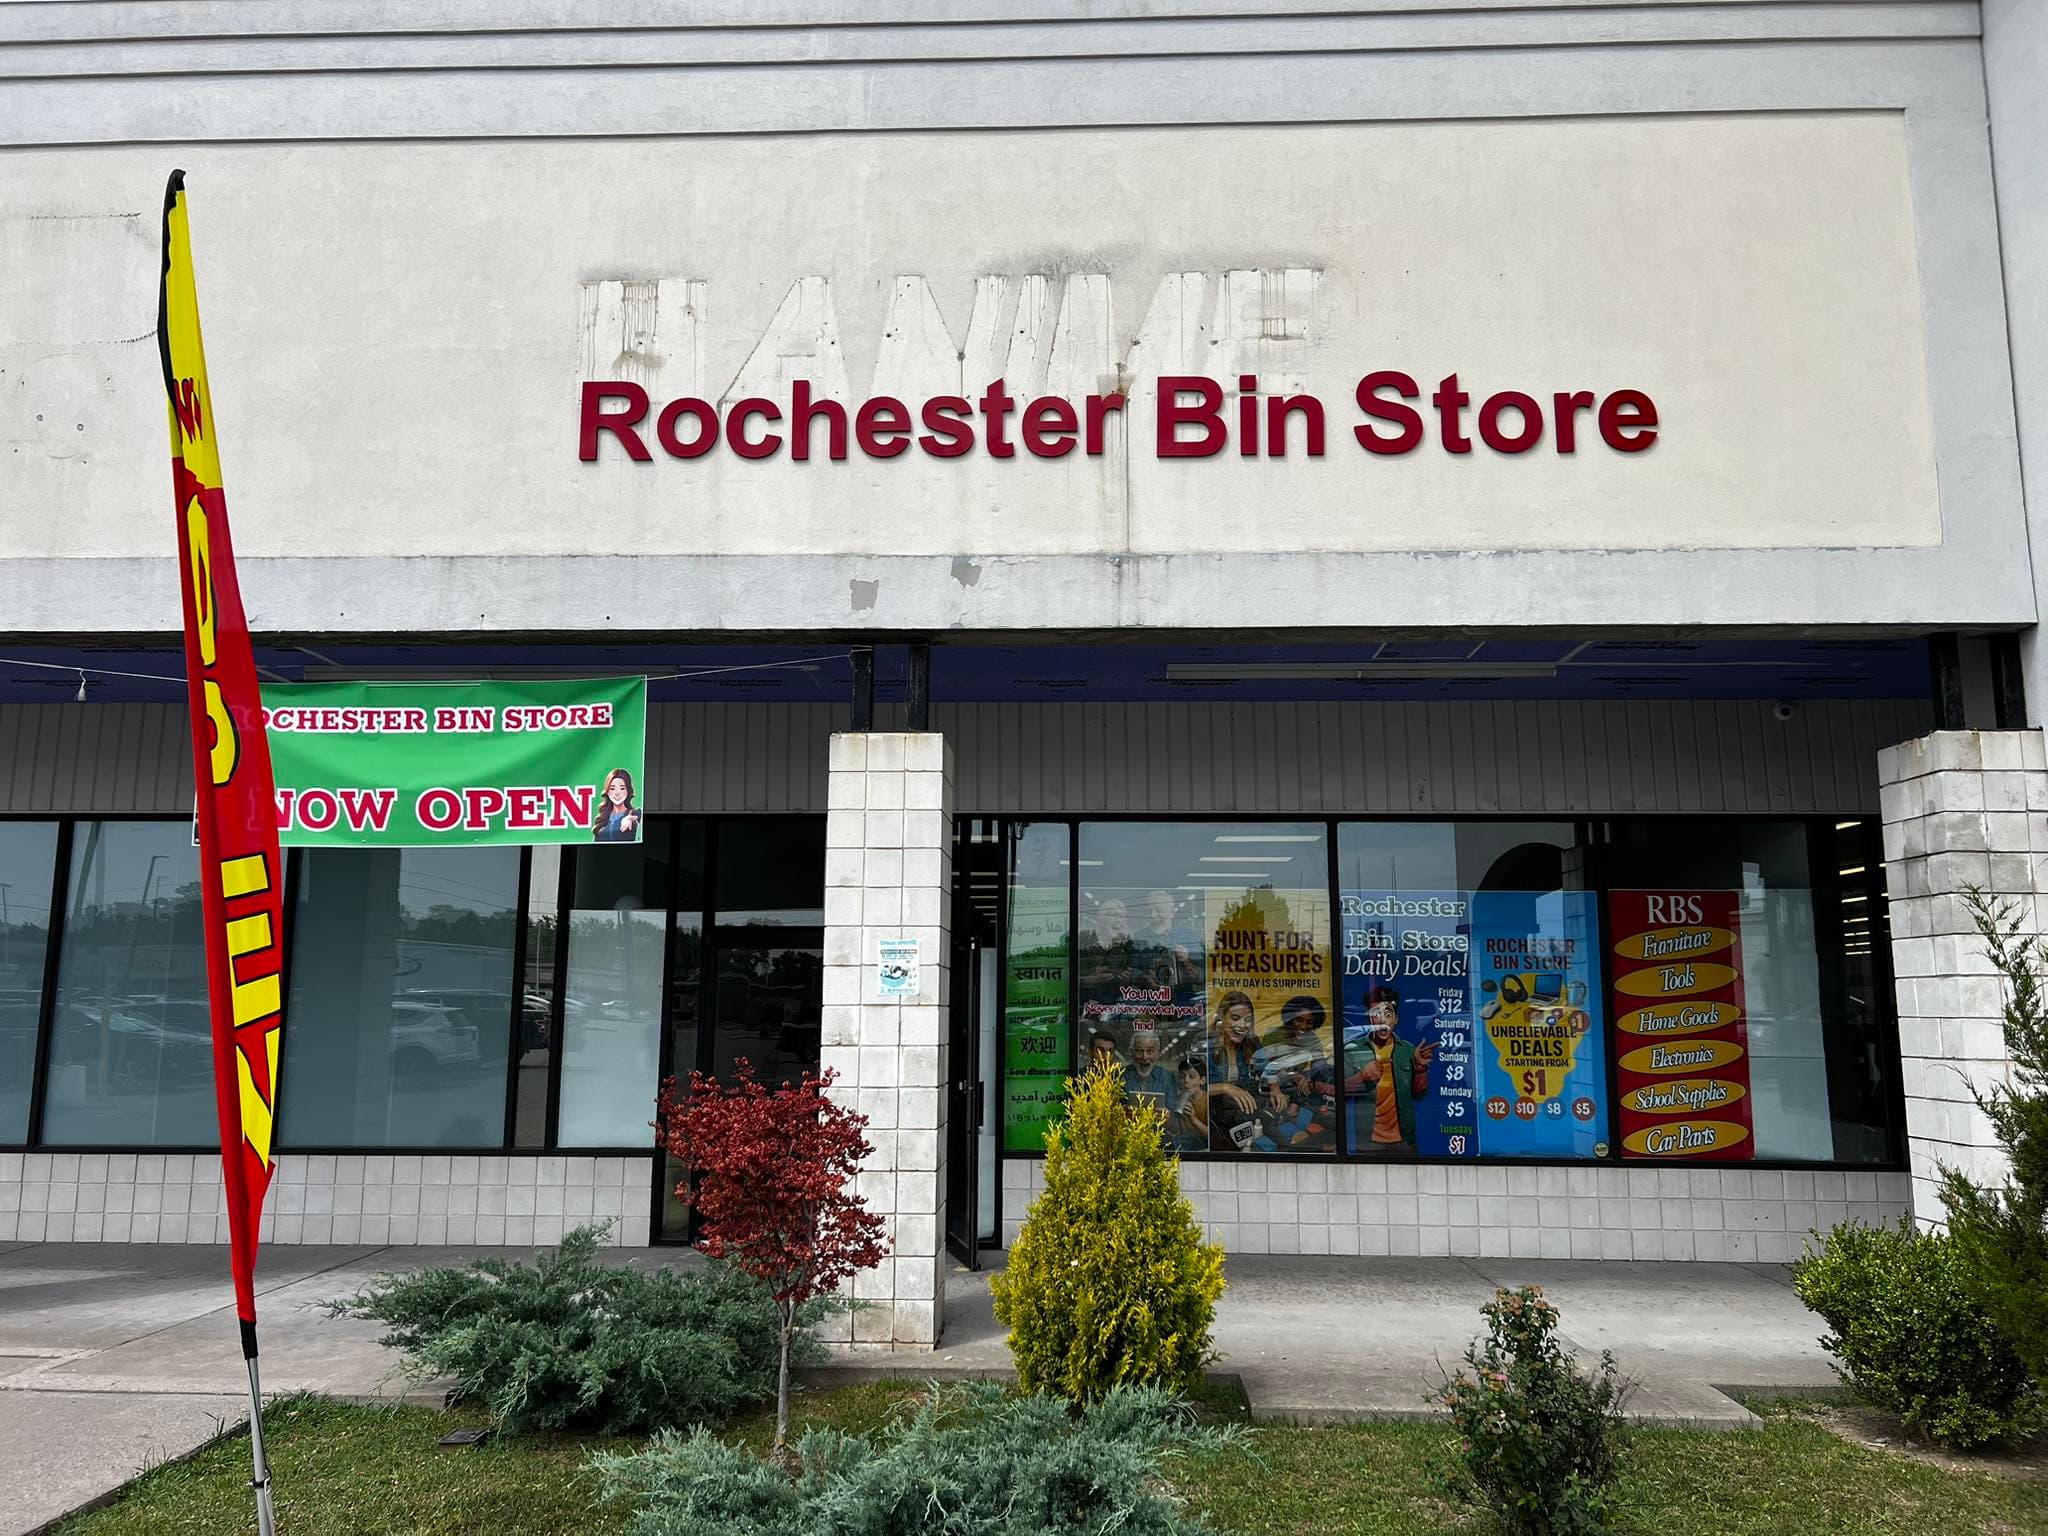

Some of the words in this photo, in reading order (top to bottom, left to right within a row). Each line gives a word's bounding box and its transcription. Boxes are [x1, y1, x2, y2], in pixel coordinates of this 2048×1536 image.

[579, 377, 1126, 461] Rochester
[1156, 375, 1326, 459] Bin
[1354, 371, 1660, 456] Store
[262, 706, 425, 733] CHESTER
[434, 706, 494, 732] BIN
[504, 702, 613, 730] STORE
[416, 786, 596, 832] OPEN
[1341, 896, 1466, 917] Rochester
[1646, 895, 1703, 924] RBS
[1215, 930, 1268, 950] HUNT
[1274, 930, 1314, 951] FOR
[1350, 929, 1395, 950] Bin
[1401, 930, 1469, 951] Store
[1486, 938, 1576, 953] ROCHESTER
[1641, 930, 1712, 958] Furniture
[1209, 953, 1323, 974] TREASURES
[1344, 953, 1400, 981] Daily
[1403, 953, 1468, 976] Deals!
[1493, 955, 1519, 970] BIN
[1524, 955, 1572, 970] STORE
[1213, 979, 1240, 988] EVERY
[1243, 979, 1260, 988] DAY
[1262, 979, 1271, 988] IS
[1273, 979, 1320, 988] SURPRISE!
[1659, 964, 1695, 992] Tools
[1120, 986, 1147, 1000] You
[1149, 986, 1172, 1000] will
[1438, 987, 1463, 998] Friday
[1084, 1003, 1116, 1014] Never
[1117, 1003, 1147, 1014] Know
[1147, 1003, 1175, 1015] what
[1175, 1004, 1204, 1018] you'll
[1439, 998, 1463, 1014] $12
[1133, 1019, 1154, 1031] find
[1434, 1019, 1471, 1029] Saturday
[1571, 1014, 1584, 1029] $1
[1638, 1012, 1679, 1032] Home
[1680, 1003, 1719, 1027] Goods
[1440, 1032, 1464, 1047] $10
[1491, 1026, 1577, 1038] UNBELIEVABLE
[1021, 1036, 1057, 1054] 欢迎
[1510, 1040, 1563, 1056] DEALS
[1439, 1052, 1468, 1063] Sunday
[1505, 1058, 1544, 1067] STARTING
[1546, 1058, 1569, 1067] FROM
[1650, 1044, 1714, 1069] Electronics
[1446, 1065, 1464, 1081] $8
[1522, 1069, 1547, 1096] $1
[1440, 1086, 1472, 1098] Monday
[1635, 1086, 1676, 1110] School
[1676, 1080, 1727, 1110] Supplies
[1447, 1101, 1465, 1117] $5
[1487, 1102, 1506, 1114] $12
[1516, 1102, 1535, 1115] $10
[1547, 1102, 1561, 1115] $8
[1576, 1103, 1590, 1115] $5
[1440, 1124, 1473, 1134] Tuesday
[1449, 1135, 1466, 1155] $1
[1646, 1129, 1677, 1154] Car
[1678, 1124, 1715, 1149] Parts
